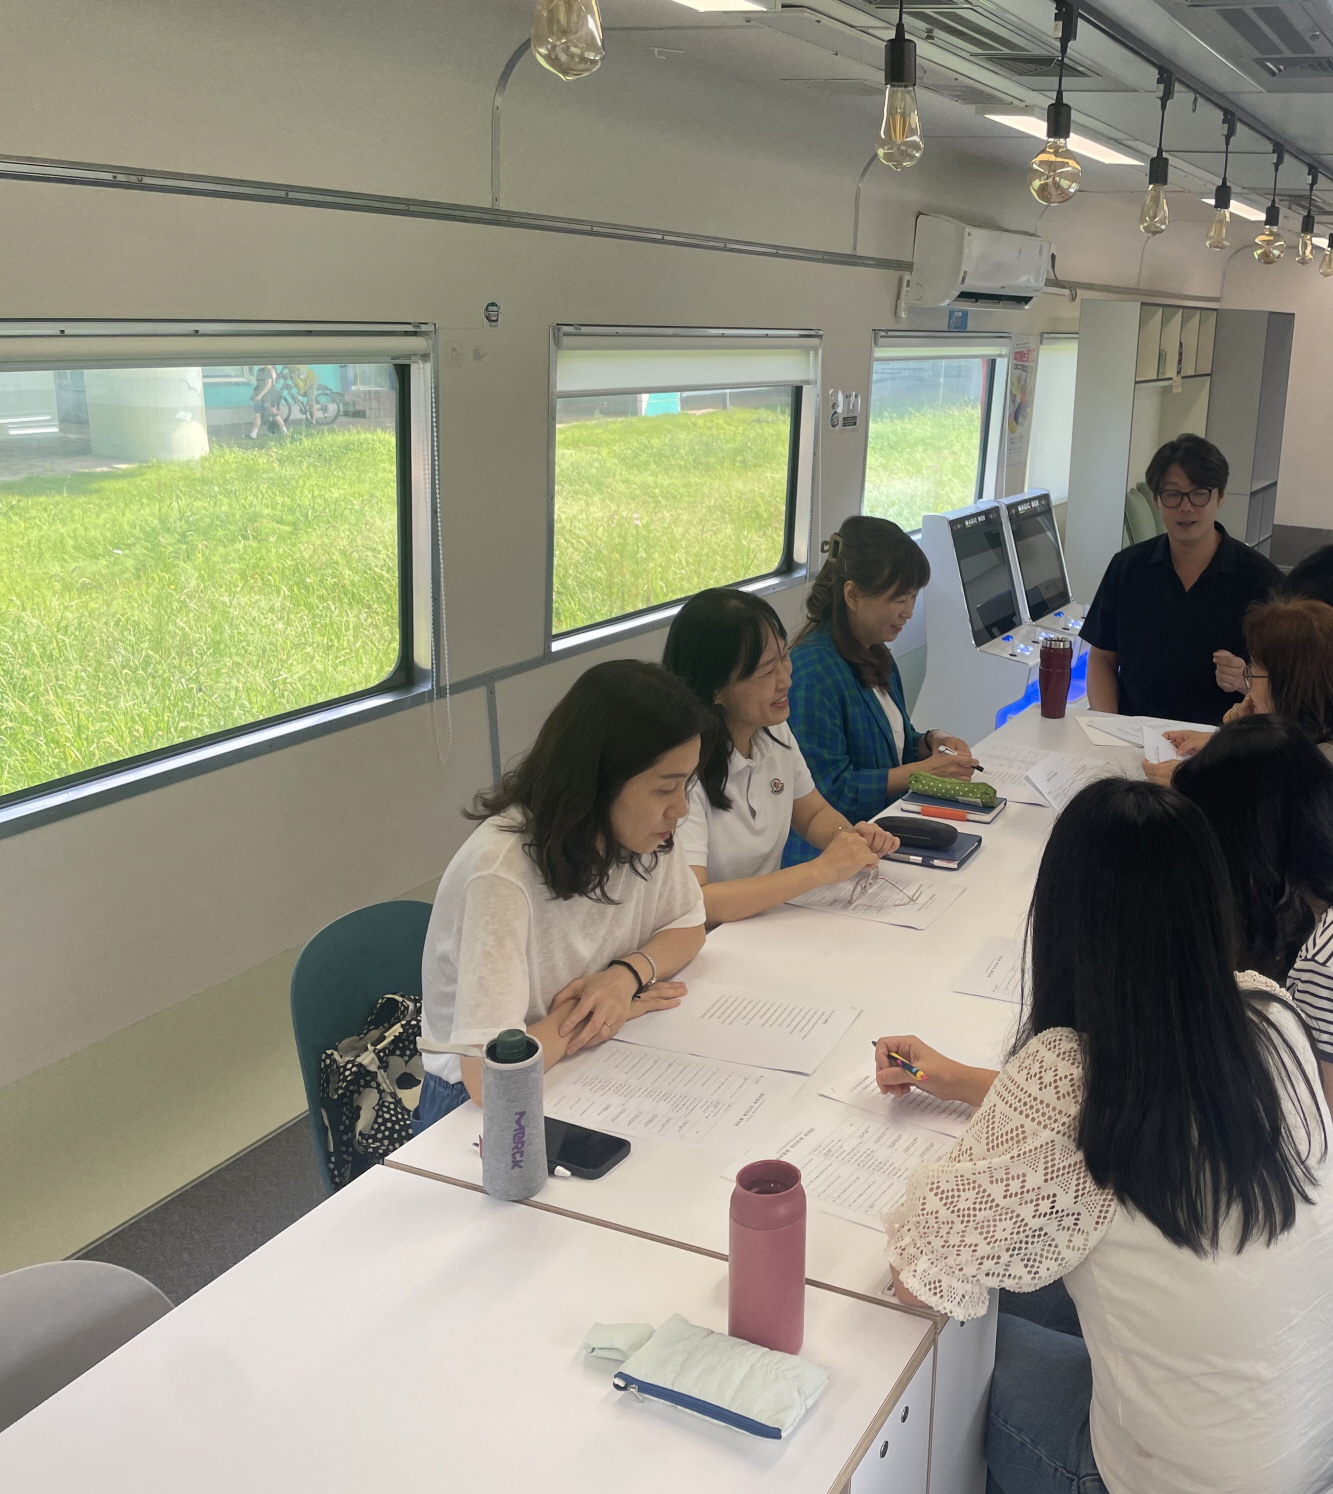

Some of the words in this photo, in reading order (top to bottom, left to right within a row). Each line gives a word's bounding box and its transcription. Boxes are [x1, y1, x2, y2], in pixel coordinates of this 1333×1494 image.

[1018, 502, 1030, 511] MAGIC
[1031, 500, 1039, 508] BOX
[965, 517, 977, 525] MAGIC
